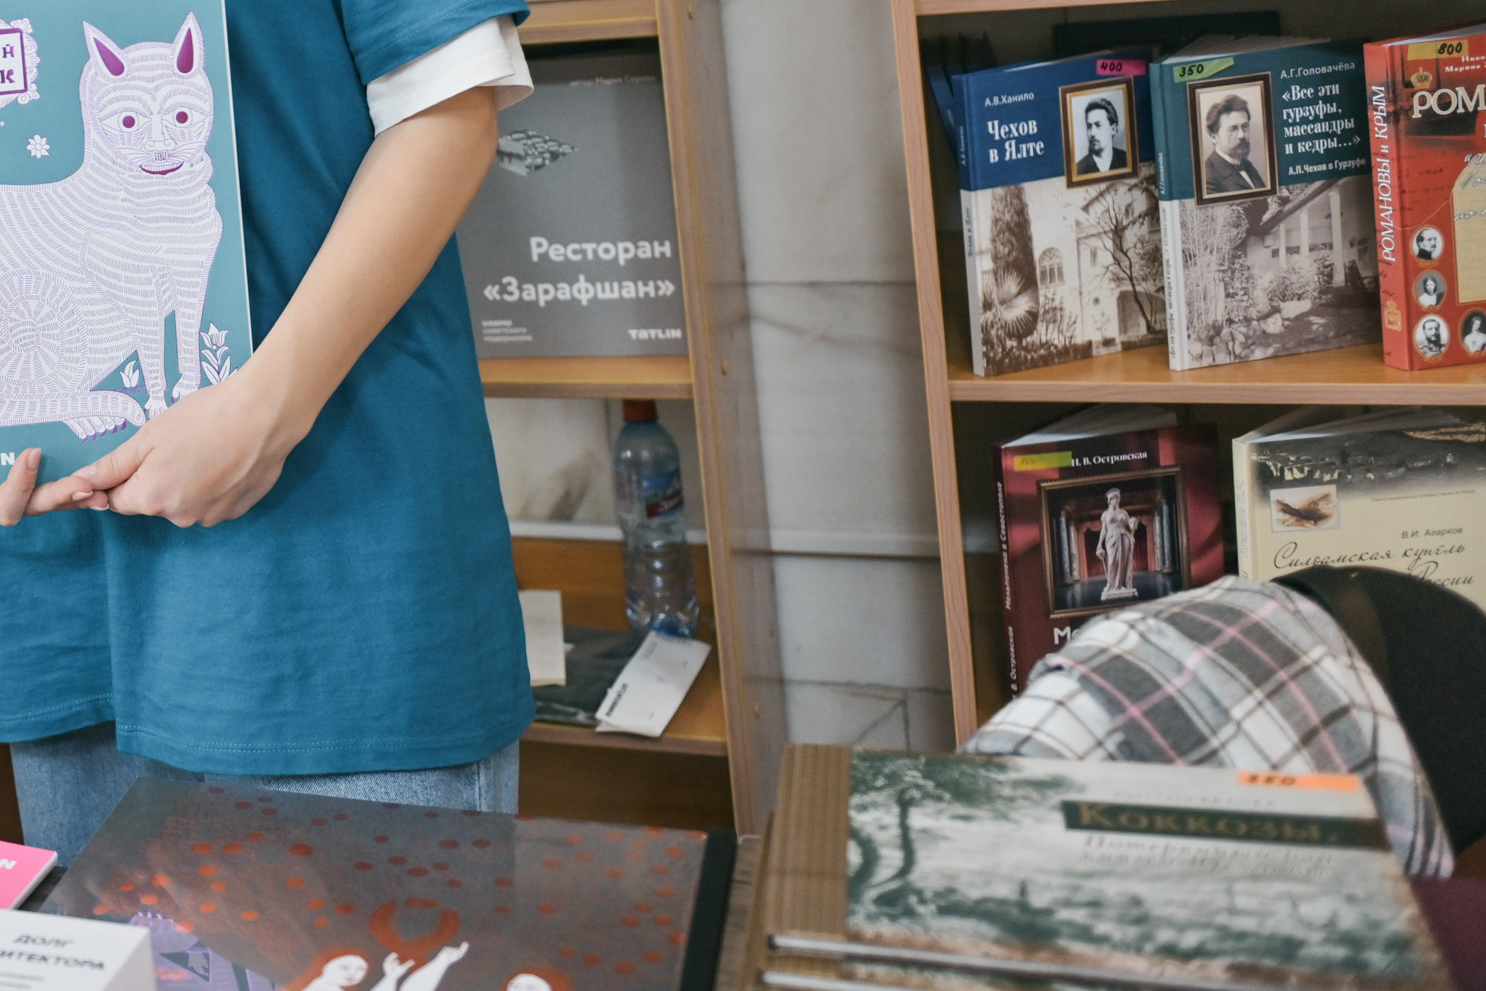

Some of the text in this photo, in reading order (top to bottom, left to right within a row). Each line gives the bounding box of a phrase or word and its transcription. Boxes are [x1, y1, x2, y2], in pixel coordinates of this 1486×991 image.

[1437, 42, 1463, 56] 800
[1100, 61, 1123, 72] 400
[1179, 64, 1204, 77] 350
[1280, 61, 1356, 79] А.Г.Головачёва
[1444, 63, 1481, 73] Марина
[985, 91, 1034, 107] А.В.Ханило
[1281, 84, 1340, 102] «Все эти
[1282, 99, 1343, 121] гурзуфы,
[987, 117, 1038, 141] Чехов
[1284, 116, 1355, 138] массандры
[989, 139, 1045, 163] в Ялте
[1285, 142, 1294, 155] и
[1334, 157, 1366, 171] Гурзуфе
[1371, 85, 1396, 262] РОМАНОВЫ КРЫМ
[530, 236, 671, 266] Ресторан
[482, 274, 676, 307] «Зарафшан»
[1092, 451, 1148, 466] Островская
[1424, 526, 1463, 538] Агарков
[1273, 541, 1467, 570] Силоамская купель
[12, 933, 75, 949] ДОЛГ
